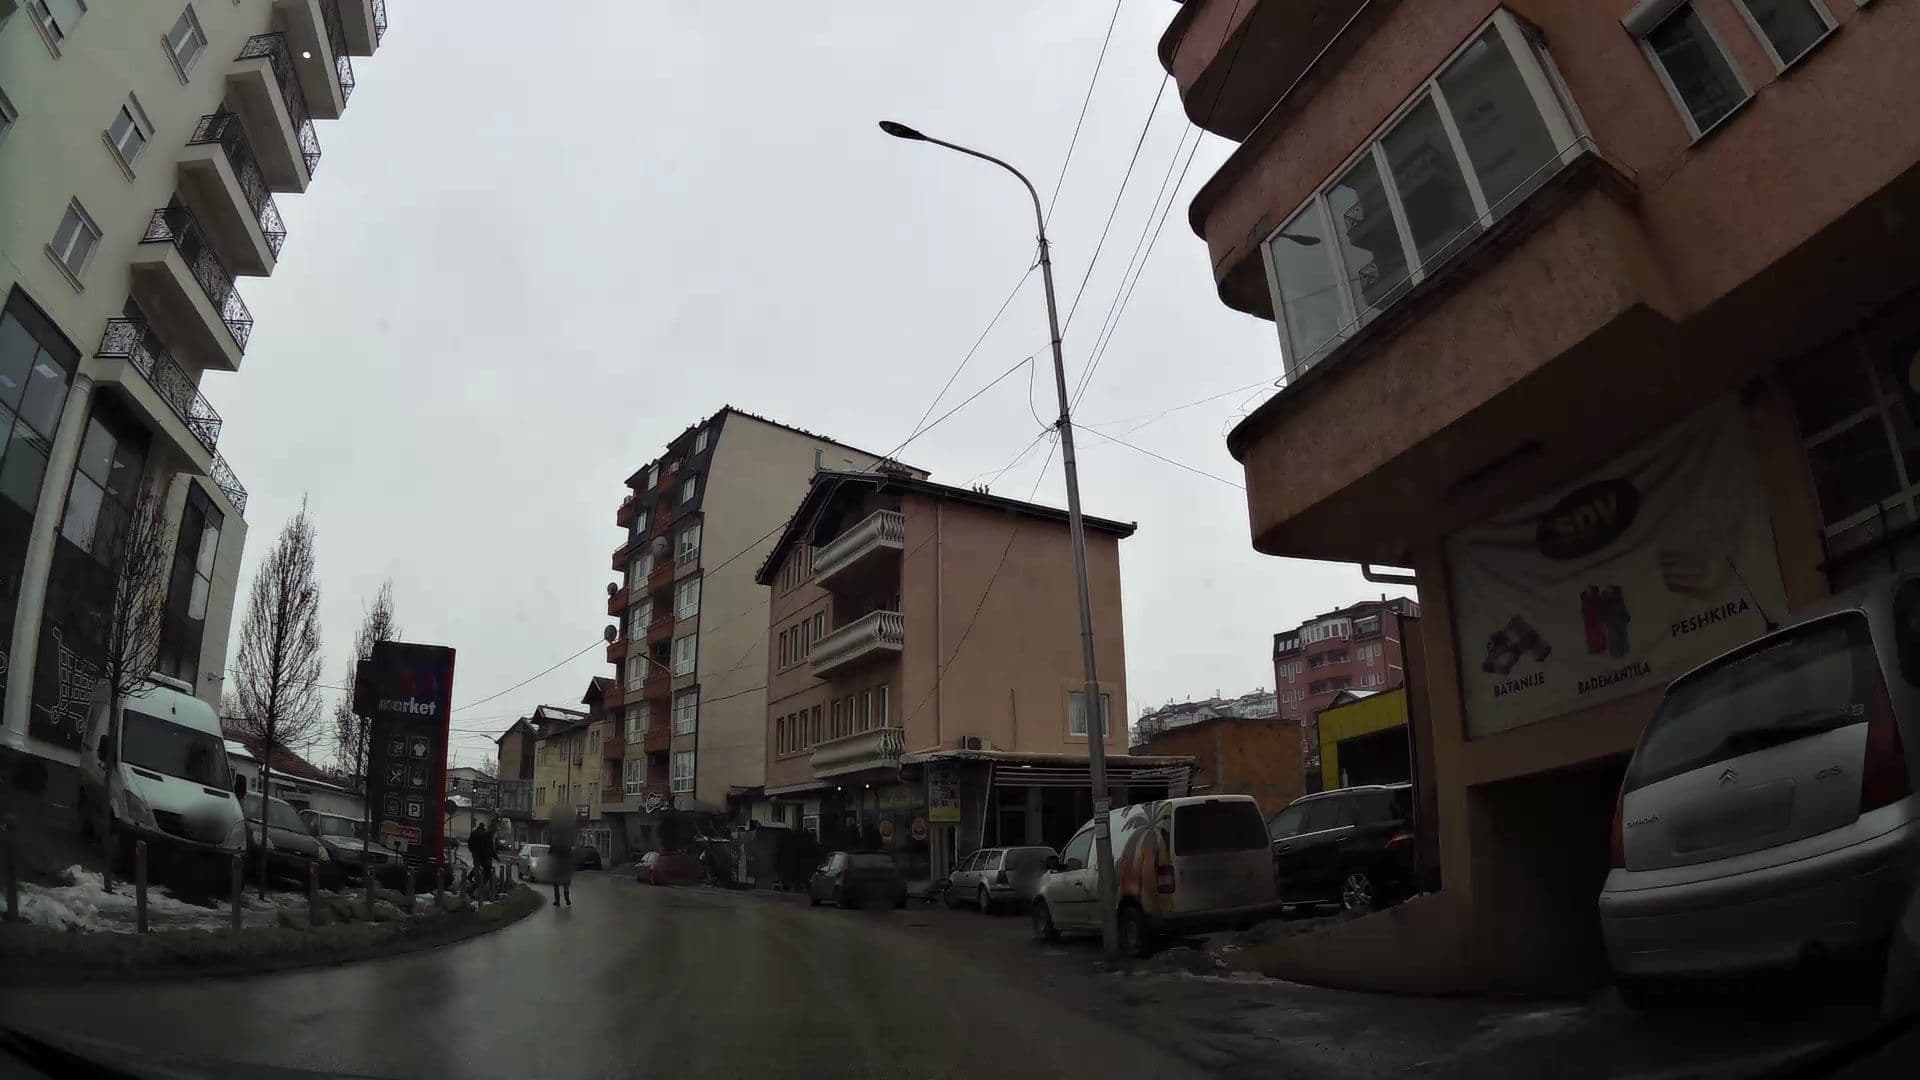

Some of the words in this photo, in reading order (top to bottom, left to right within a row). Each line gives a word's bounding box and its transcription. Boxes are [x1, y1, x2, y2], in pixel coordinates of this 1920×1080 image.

[1671, 597, 1749, 636] PESHKIRA
[1494, 671, 1545, 696] BATANIJE
[378, 697, 436, 715] market
